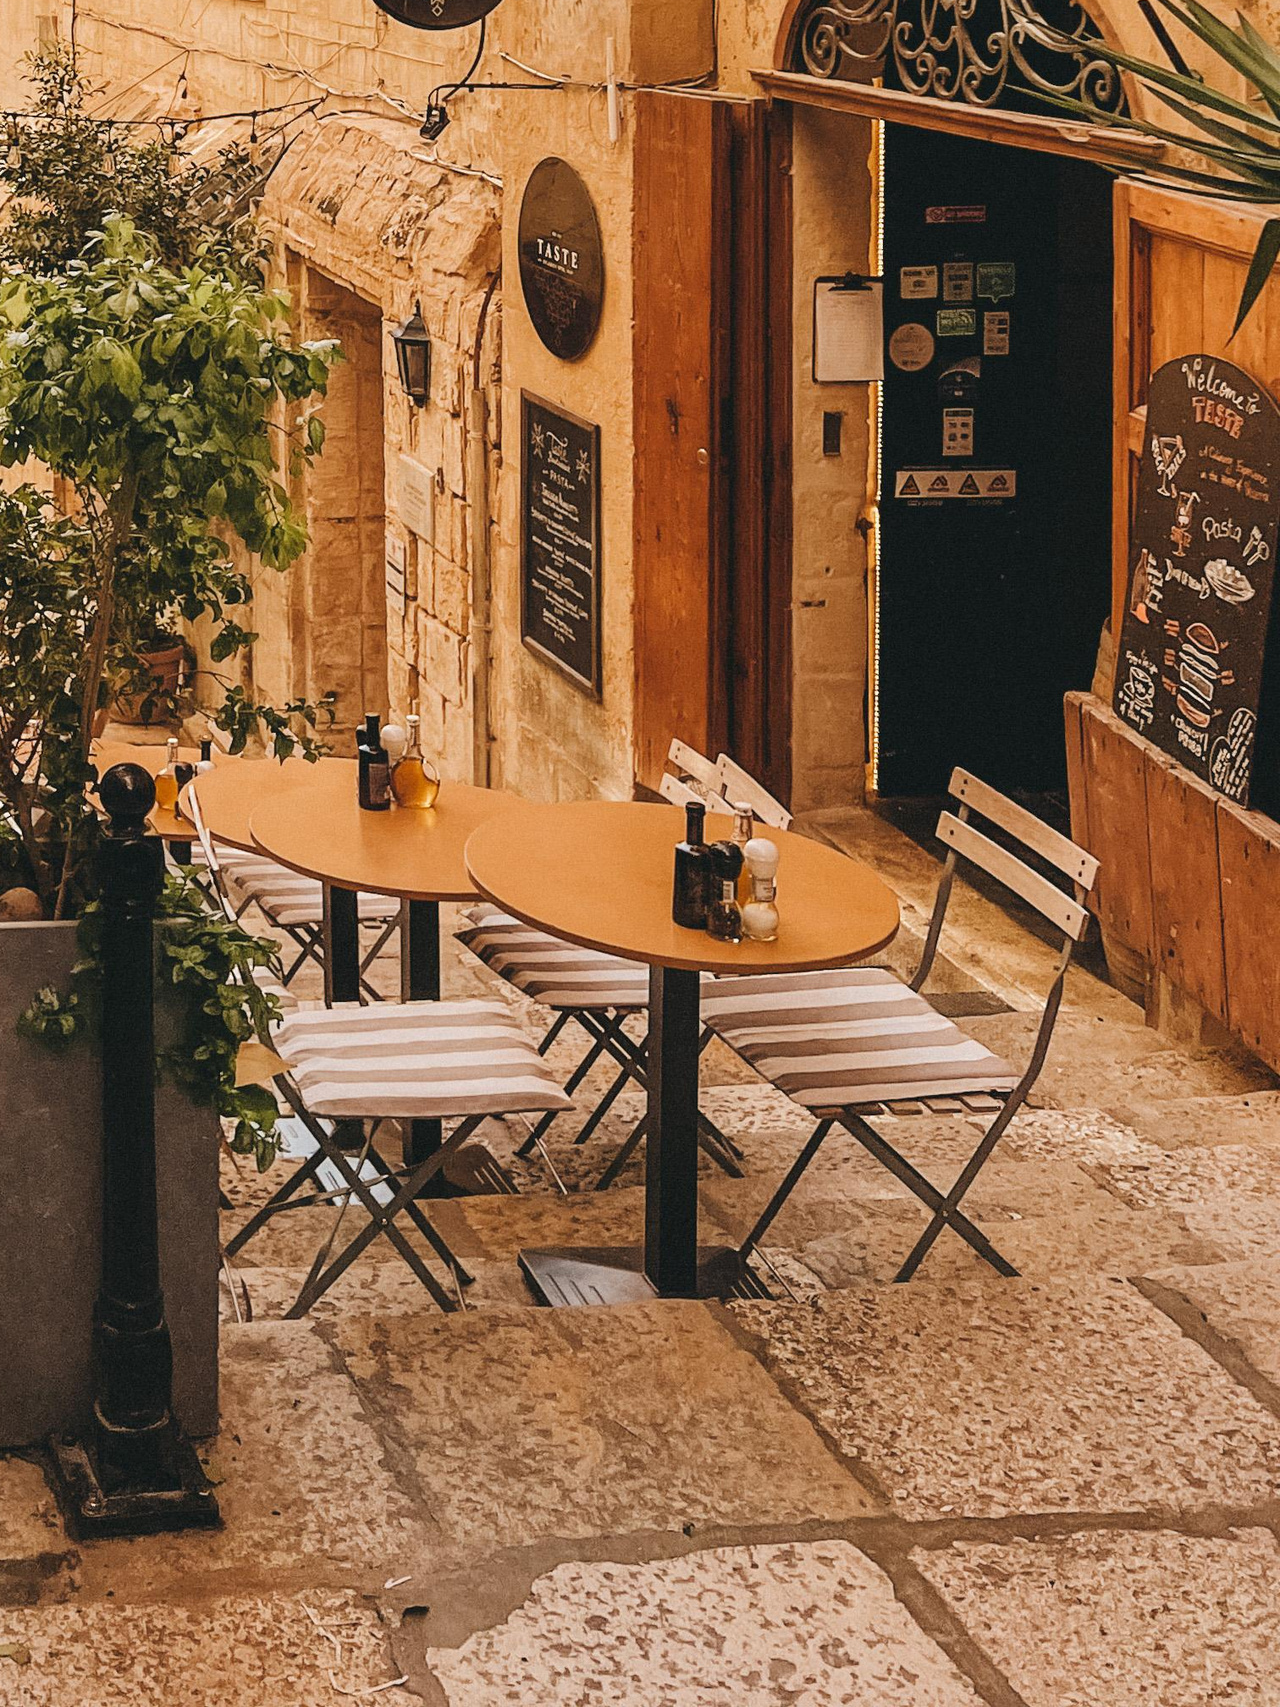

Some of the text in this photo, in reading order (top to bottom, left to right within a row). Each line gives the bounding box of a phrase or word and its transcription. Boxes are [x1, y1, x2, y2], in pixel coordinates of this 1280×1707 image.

[536, 238, 578, 269] TASTE
[1181, 358, 1244, 411] Welcome
[1202, 516, 1242, 543] Pasta
